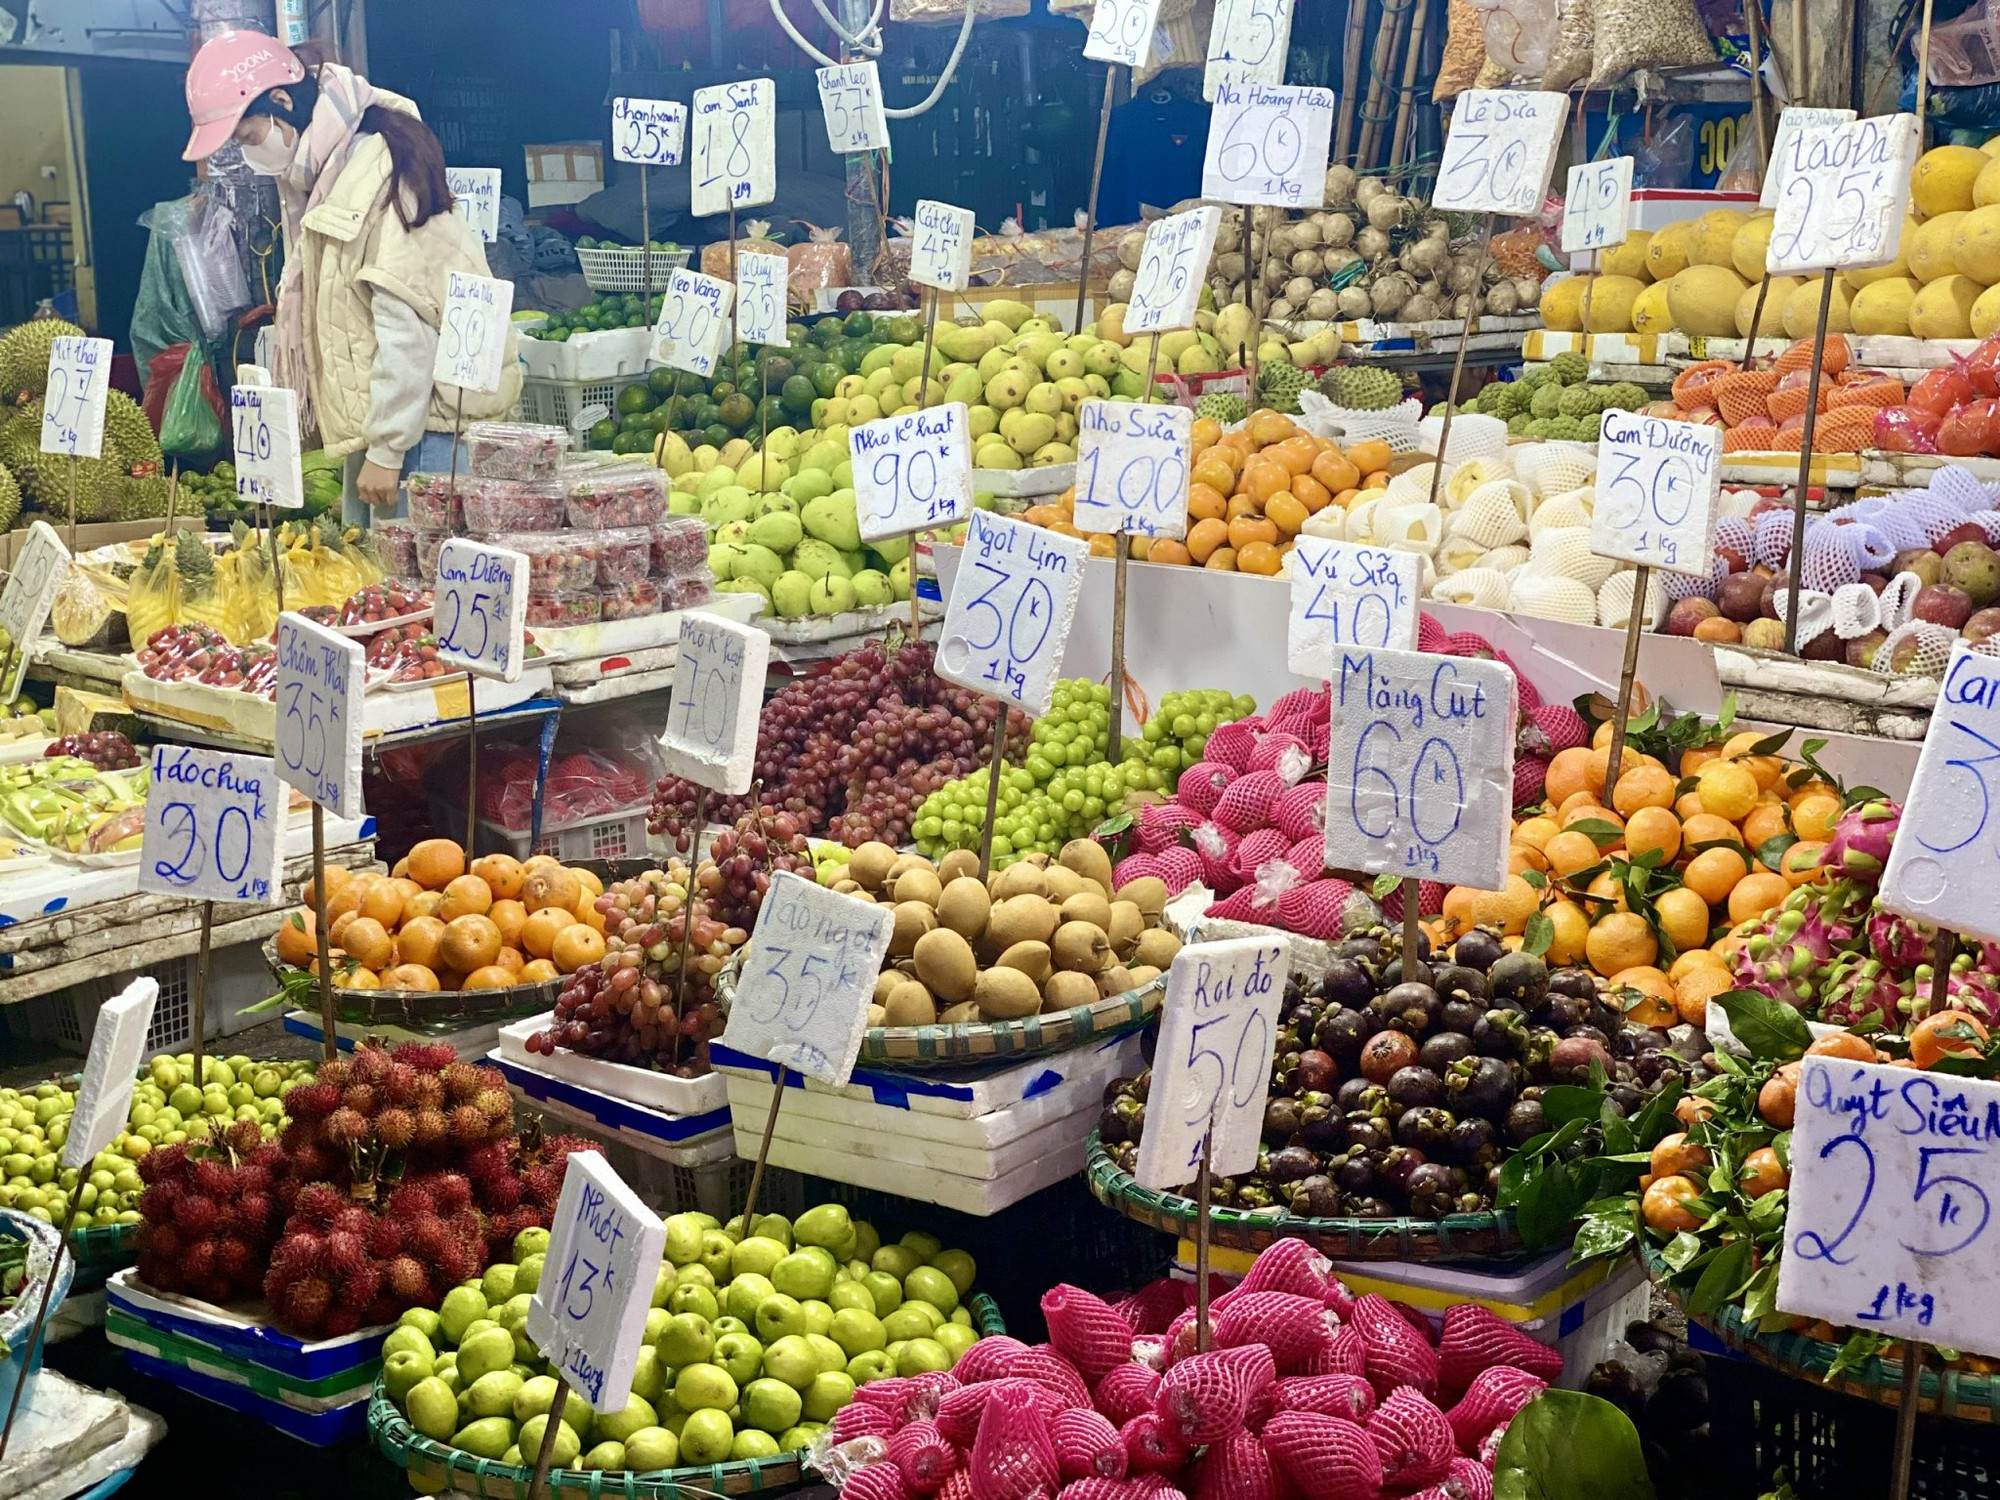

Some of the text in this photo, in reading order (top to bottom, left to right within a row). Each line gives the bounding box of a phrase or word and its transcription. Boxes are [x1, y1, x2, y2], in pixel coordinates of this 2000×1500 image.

[694, 89, 723, 115] Cam
[1216, 82, 1241, 106] Na
[1464, 92, 1538, 124] Lê Sữa
[699, 111, 751, 188] 18
[1083, 403, 1178, 443] Nho Sữa
[1603, 413, 1643, 445] Cam
[854, 428, 890, 455] Nho
[439, 545, 468, 584] Cam
[1296, 547, 1341, 579] Vú
[1340, 652, 1486, 729] Măng Cụt
[1184, 1007, 1268, 1128] 50
